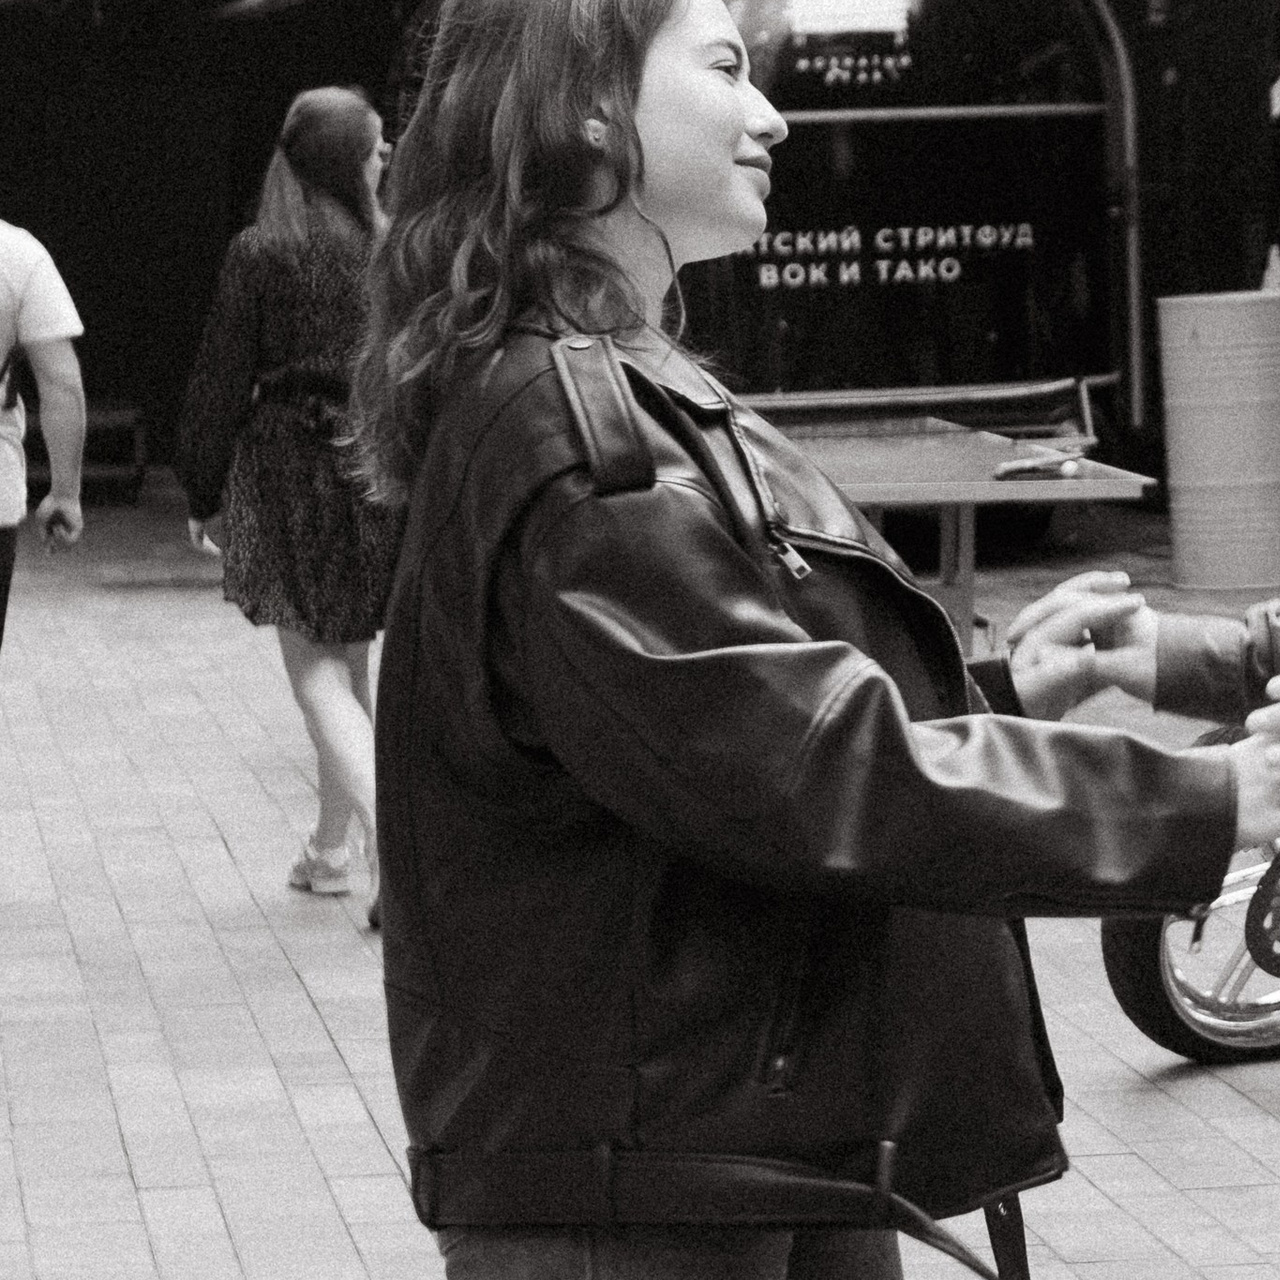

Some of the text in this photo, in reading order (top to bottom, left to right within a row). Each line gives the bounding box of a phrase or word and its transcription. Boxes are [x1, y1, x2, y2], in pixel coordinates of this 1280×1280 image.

[748, 222, 1034, 255] ТСКИЙ СТРИТФУД
[759, 257, 961, 288] ВОК И ТАКО
